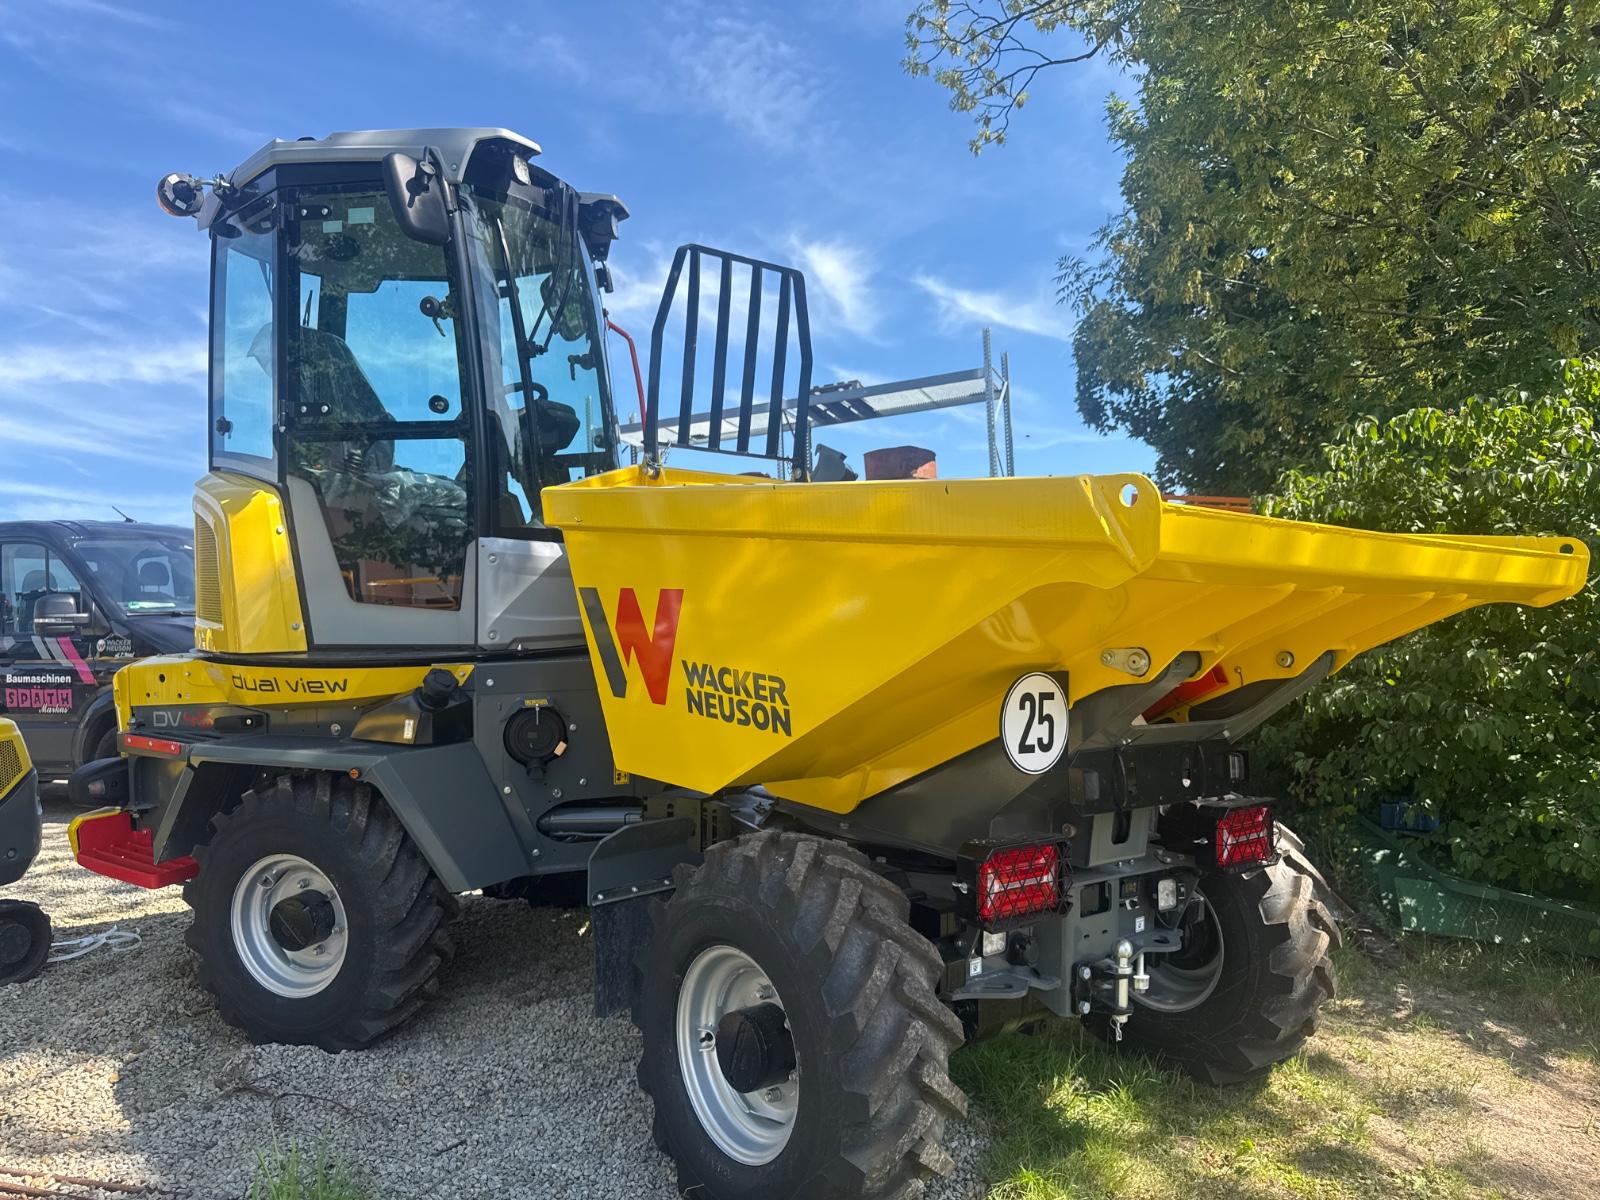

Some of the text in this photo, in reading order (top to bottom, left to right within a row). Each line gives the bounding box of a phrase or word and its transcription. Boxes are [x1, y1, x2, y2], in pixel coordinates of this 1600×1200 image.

[6, 674, 72, 683] Baumaschinen
[232, 674, 348, 693] dual view
[681, 659, 790, 706] WACKER
[7, 685, 71, 706] SPÄTH
[38, 704, 69, 714] Markus
[686, 688, 792, 737] NEUSON
[1018, 692, 1055, 754] 25
